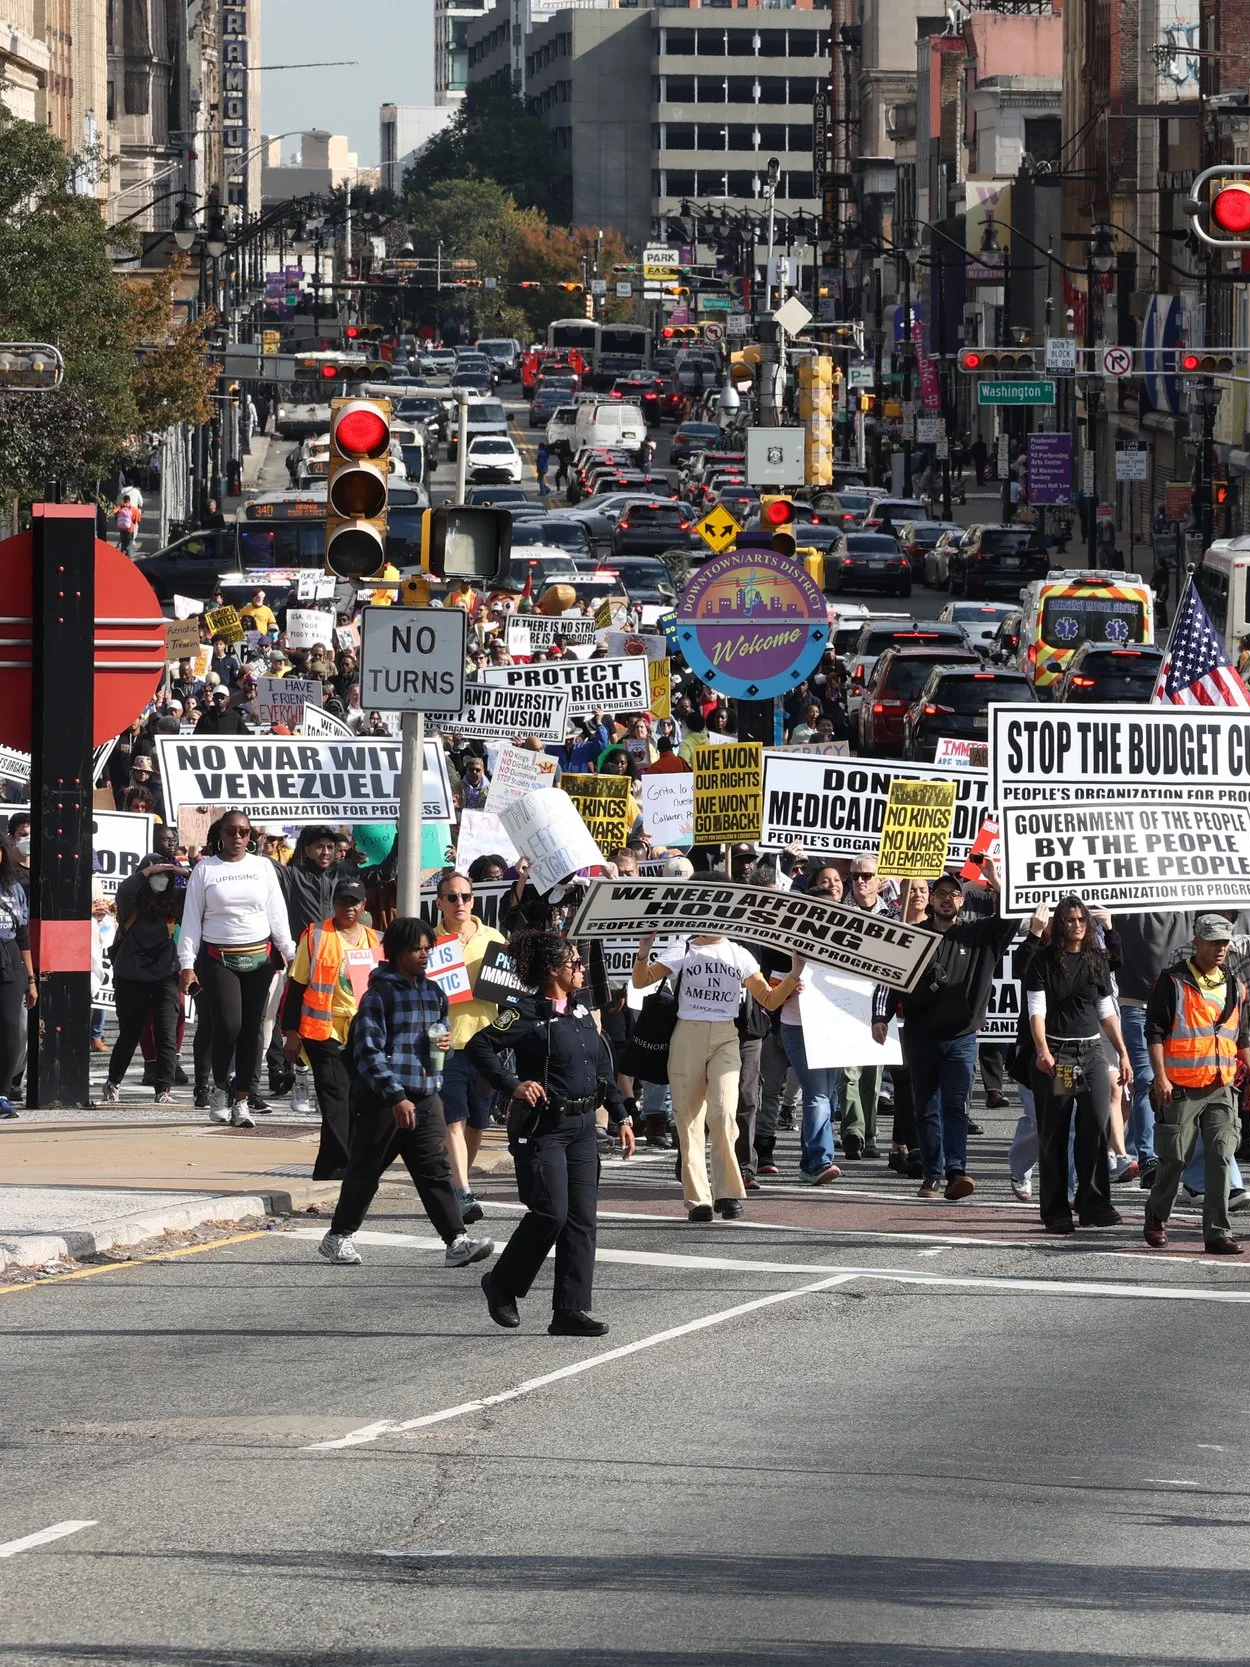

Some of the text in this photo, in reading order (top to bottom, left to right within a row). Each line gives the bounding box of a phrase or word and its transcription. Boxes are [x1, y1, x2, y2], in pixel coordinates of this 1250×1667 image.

[647, 254, 676, 262] PARK
[982, 385, 1041, 400] Washington
[683, 553, 822, 613] DOWNTOWN/ARTS DISTRICT
[211, 614, 239, 631] UNITED
[522, 619, 573, 633] THERE IS NO
[392, 625, 436, 655] NO
[711, 627, 803, 666] Welcome
[368, 669, 455, 695] TURNS
[507, 664, 623, 686] PROTECT
[285, 680, 314, 692] HAVE
[572, 681, 643, 702] RIGHTS
[272, 692, 314, 706] FRIENDS
[464, 688, 564, 712] AND DIVERSITY
[603, 700, 644, 712] PROGRESS
[467, 710, 477, 723] &
[480, 710, 551, 729] INCLUSION
[443, 724, 500, 736] ORGANIZATION
[517, 731, 559, 740] PROGRESS
[176, 745, 227, 770] NO
[234, 745, 323, 770] WAR
[503, 749, 530, 763] NO Kings
[1007, 720, 1072, 774] STOP
[1077, 721, 1122, 775] THE
[1129, 723, 1222, 777] BUDGET
[500, 758, 538, 773] NO Dictators
[696, 750, 720, 771] WE
[721, 747, 760, 770] WON
[496, 774, 512, 783] STOP
[498, 766, 537, 781] NO Dummies
[695, 771, 760, 790] OUR RIGHTS
[196, 773, 400, 800] VENEZUEL
[646, 784, 675, 801] Grita
[1003, 787, 1071, 801] PEOPLE'S
[1074, 788, 1183, 801] ORGANIZATION
[1187, 789, 1214, 802] FOR
[243, 805, 368, 816] ORGANIZATION FOR
[583, 797, 627, 819] KINGS
[695, 794, 760, 815] WE WON'T
[768, 790, 887, 833] MEDICAID
[695, 813, 760, 833] GO BACK!
[887, 806, 908, 826] NO
[909, 808, 951, 829] KINGS
[1015, 810, 1135, 836] GOVERNMENT
[1140, 810, 1160, 830] OF
[1162, 810, 1196, 830] THE
[1197, 811, 1248, 832] PEOPLE
[768, 832, 830, 848] PEOPLE'S
[883, 830, 904, 850] NO
[905, 831, 947, 853] WARS
[1035, 833, 1240, 858] BY THE PEOPLE
[880, 851, 944, 868] NO EMPIRES
[215, 874, 259, 884] UPRISING
[1026, 861, 1086, 883] FOR
[1093, 857, 1152, 880] THE
[1015, 889, 1078, 905] PEOPLE'S
[1081, 886, 1179, 901] ORGANIZATION
[1181, 885, 1205, 898] FOR
[611, 886, 916, 949] WE NEED AFFORDABLE
[643, 902, 864, 952] HOUSING
[350, 952, 371, 960] ACLU
[439, 946, 454, 965] IS
[586, 919, 905, 981] PEOPLE'S ORGANIZATION FOR PROGRESS
[685, 962, 742, 982] NO KINGS
[708, 978, 721, 988] IN
